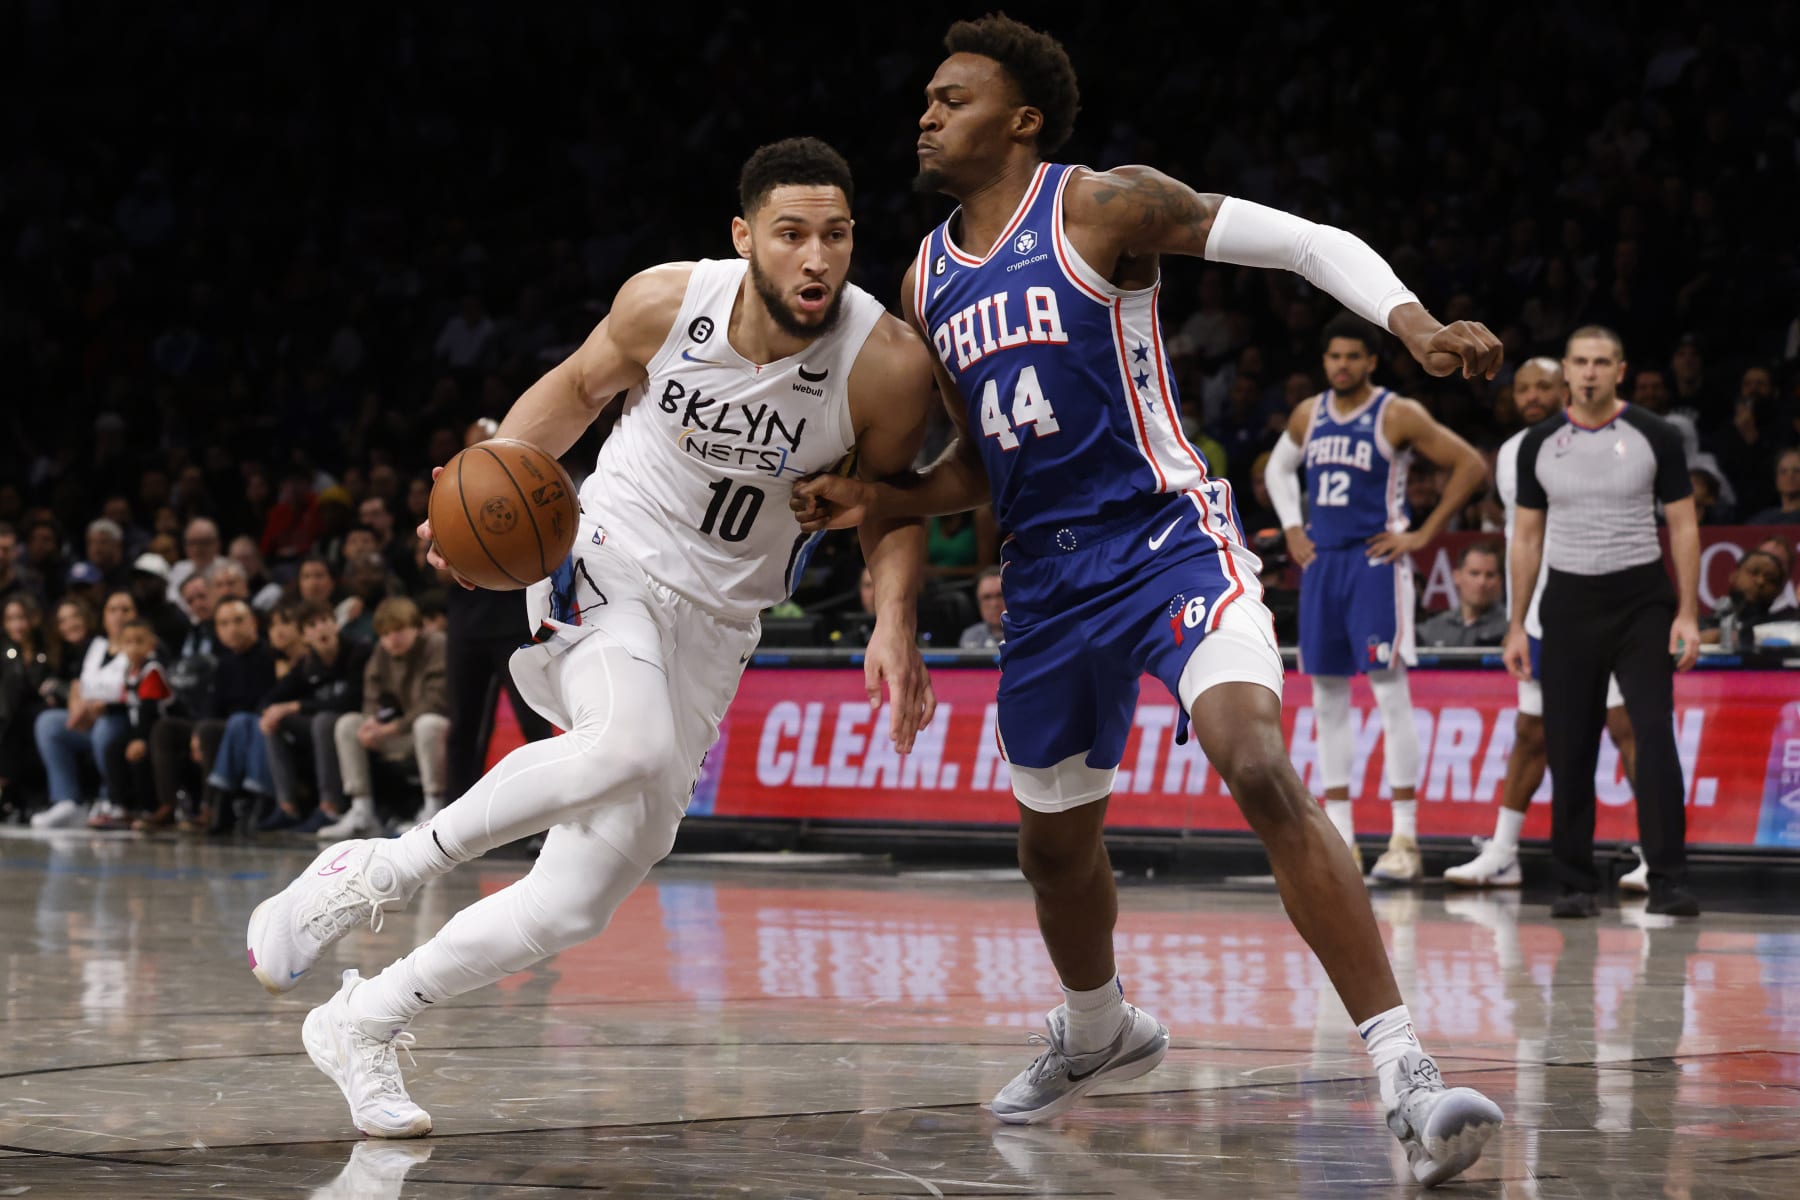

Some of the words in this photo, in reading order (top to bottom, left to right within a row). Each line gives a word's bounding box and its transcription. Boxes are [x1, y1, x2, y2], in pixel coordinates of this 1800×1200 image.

[1006, 253, 1048, 273] crypto.com
[692, 320, 711, 342] 6
[933, 286, 1069, 384] PHILA
[658, 379, 807, 453] BKLYN
[792, 383, 823, 398] Webull
[980, 365, 1061, 451] 44
[1306, 435, 1372, 472] PHILA
[699, 476, 765, 542] 10
[1316, 470, 1351, 506] 12
[756, 700, 960, 790] CLEAN.
